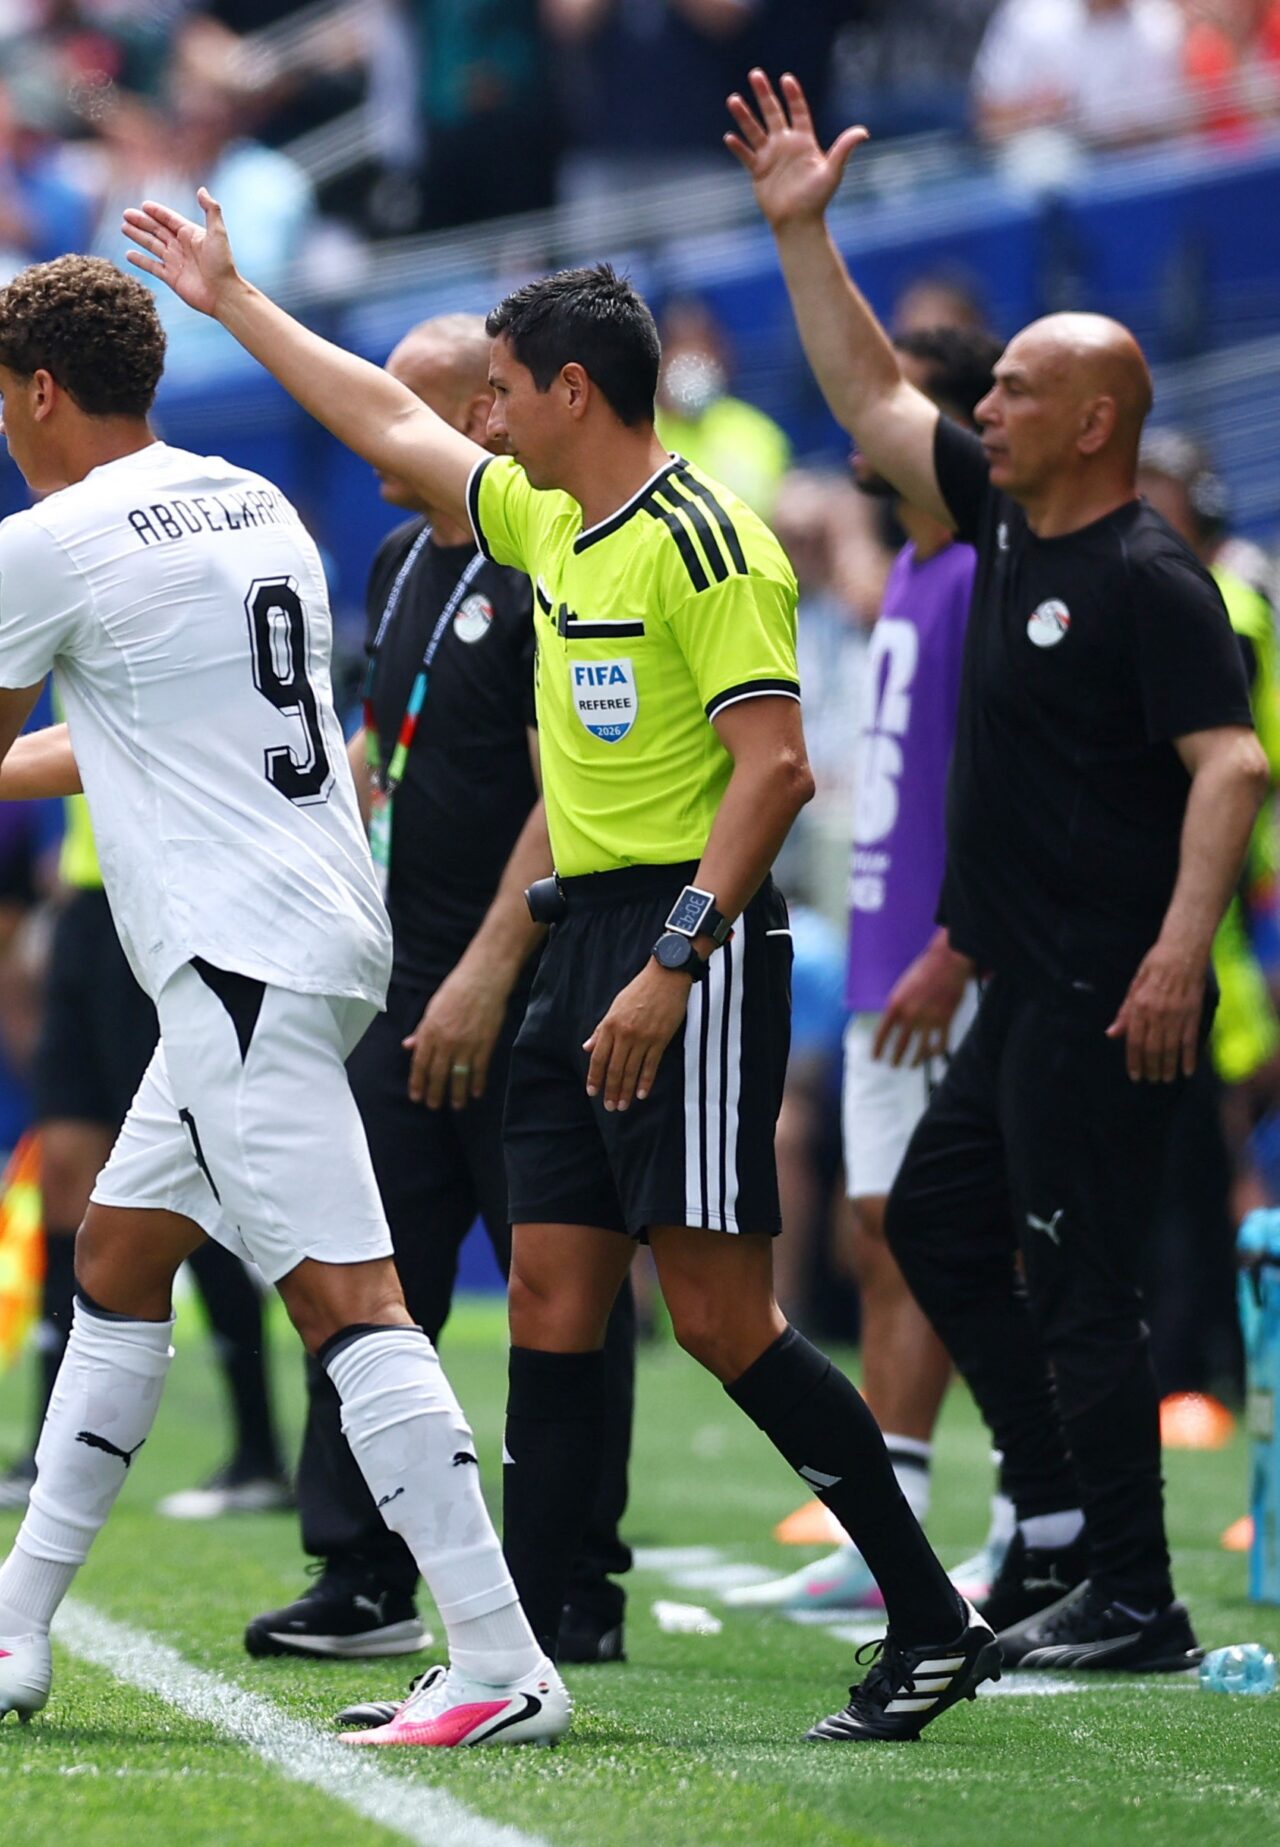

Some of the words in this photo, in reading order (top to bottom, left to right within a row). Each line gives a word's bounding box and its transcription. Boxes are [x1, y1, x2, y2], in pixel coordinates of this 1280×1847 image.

[575, 665, 628, 687] FIFA
[244, 575, 336, 807] 9
[578, 697, 632, 711] REFEREE
[597, 726, 622, 736] 2026
